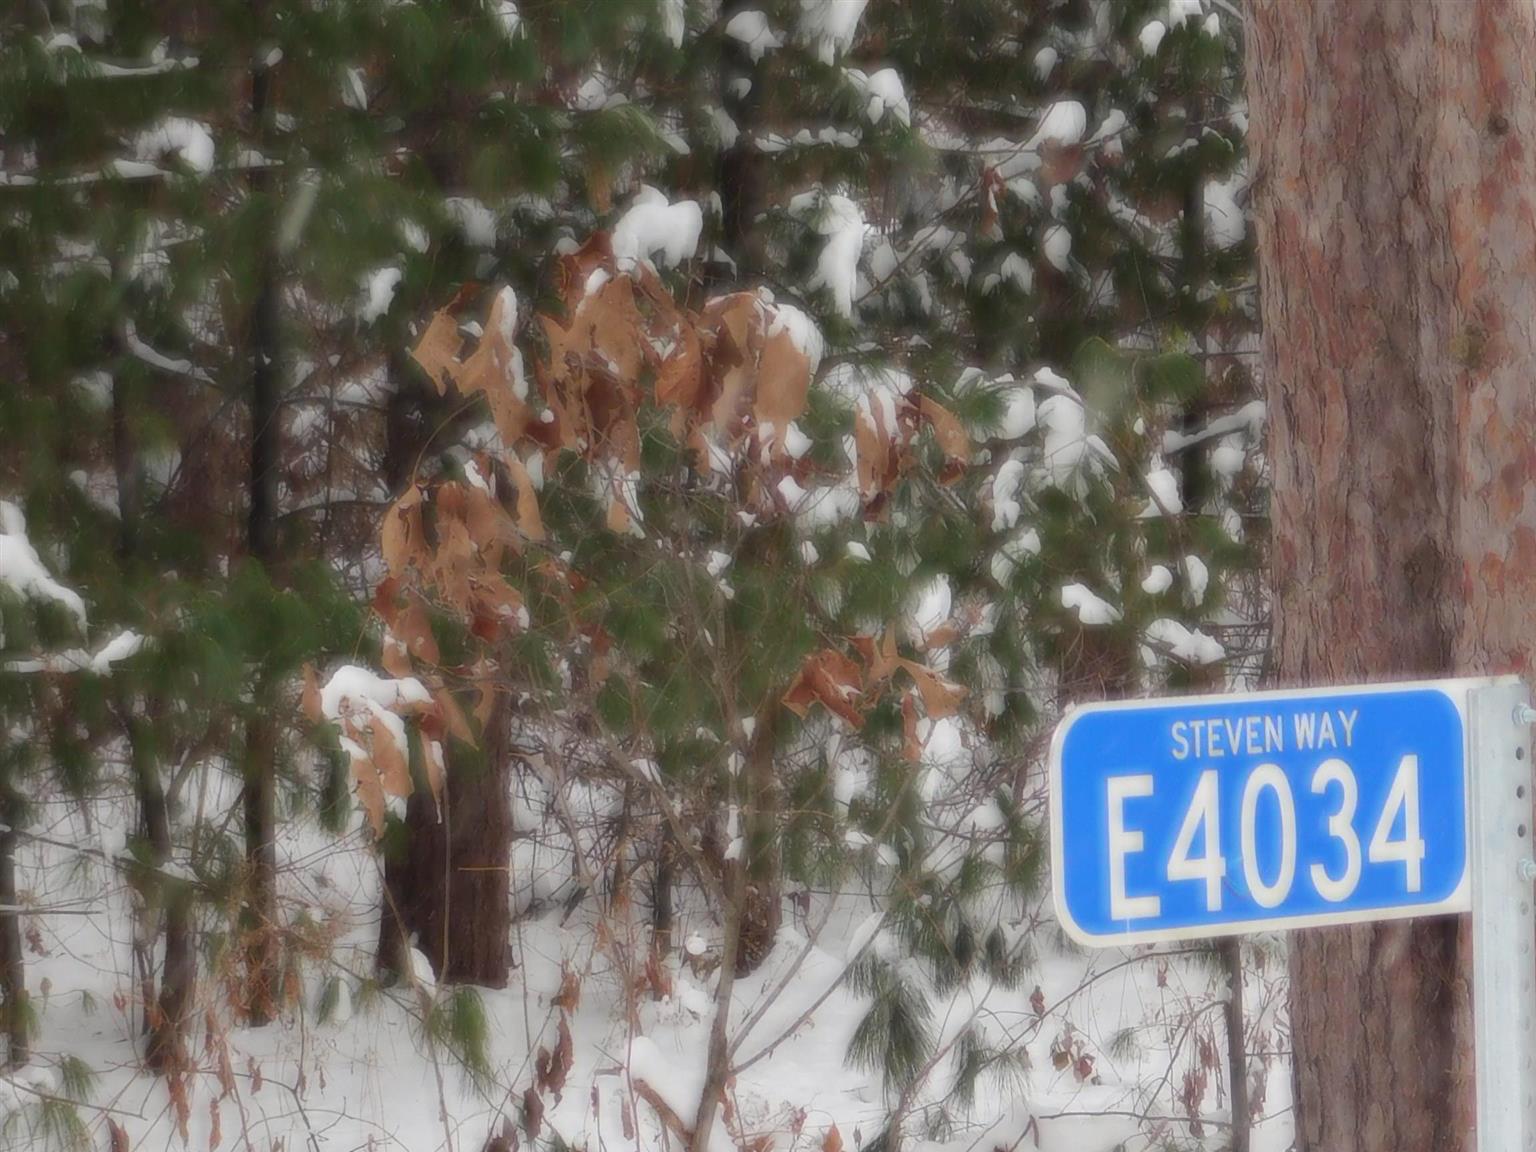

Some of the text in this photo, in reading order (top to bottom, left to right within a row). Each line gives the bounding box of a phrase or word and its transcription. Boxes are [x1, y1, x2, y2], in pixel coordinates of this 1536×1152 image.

[1171, 710, 1359, 761] STEVEN WAY
[1105, 753, 1426, 922] E4034
